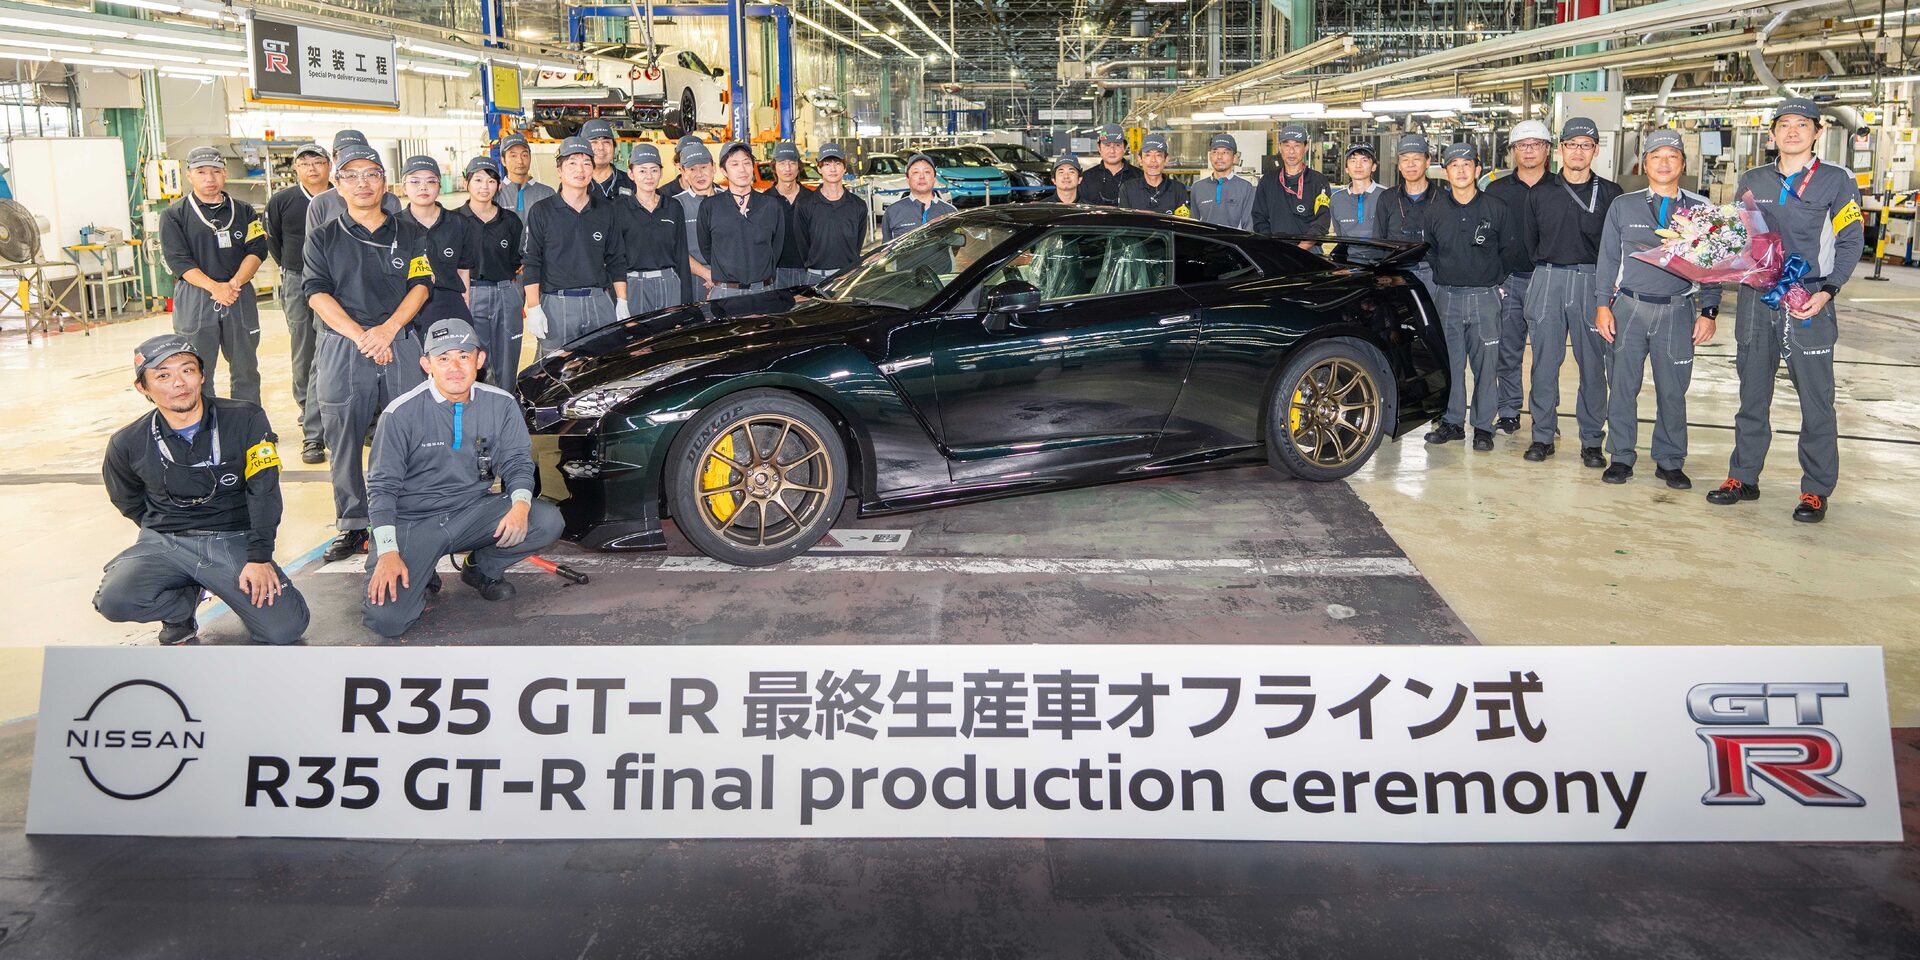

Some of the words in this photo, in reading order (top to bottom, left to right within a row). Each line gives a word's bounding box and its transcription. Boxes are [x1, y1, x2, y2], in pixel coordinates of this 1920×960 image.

[262, 38, 290, 53] GT
[307, 45, 387, 75] 架装工程
[264, 50, 292, 75] R
[308, 69, 327, 79] Special
[337, 73, 356, 82] delivery
[356, 75, 378, 85] assembly
[1802, 348, 1831, 356] NISSAN
[687, 405, 744, 464] DUNLOP
[341, 677, 491, 736] R35
[518, 677, 719, 736] GT-R
[742, 670, 1548, 744] 最終生産車オフライン式
[1686, 682, 1849, 726] GT
[67, 730, 205, 749] NISSAN
[1695, 727, 1867, 807] R
[244, 755, 380, 810] R35
[403, 757, 586, 811] GT-R
[606, 752, 774, 811] final
[800, 753, 1225, 826] production
[1249, 769, 1648, 830] ceremony
